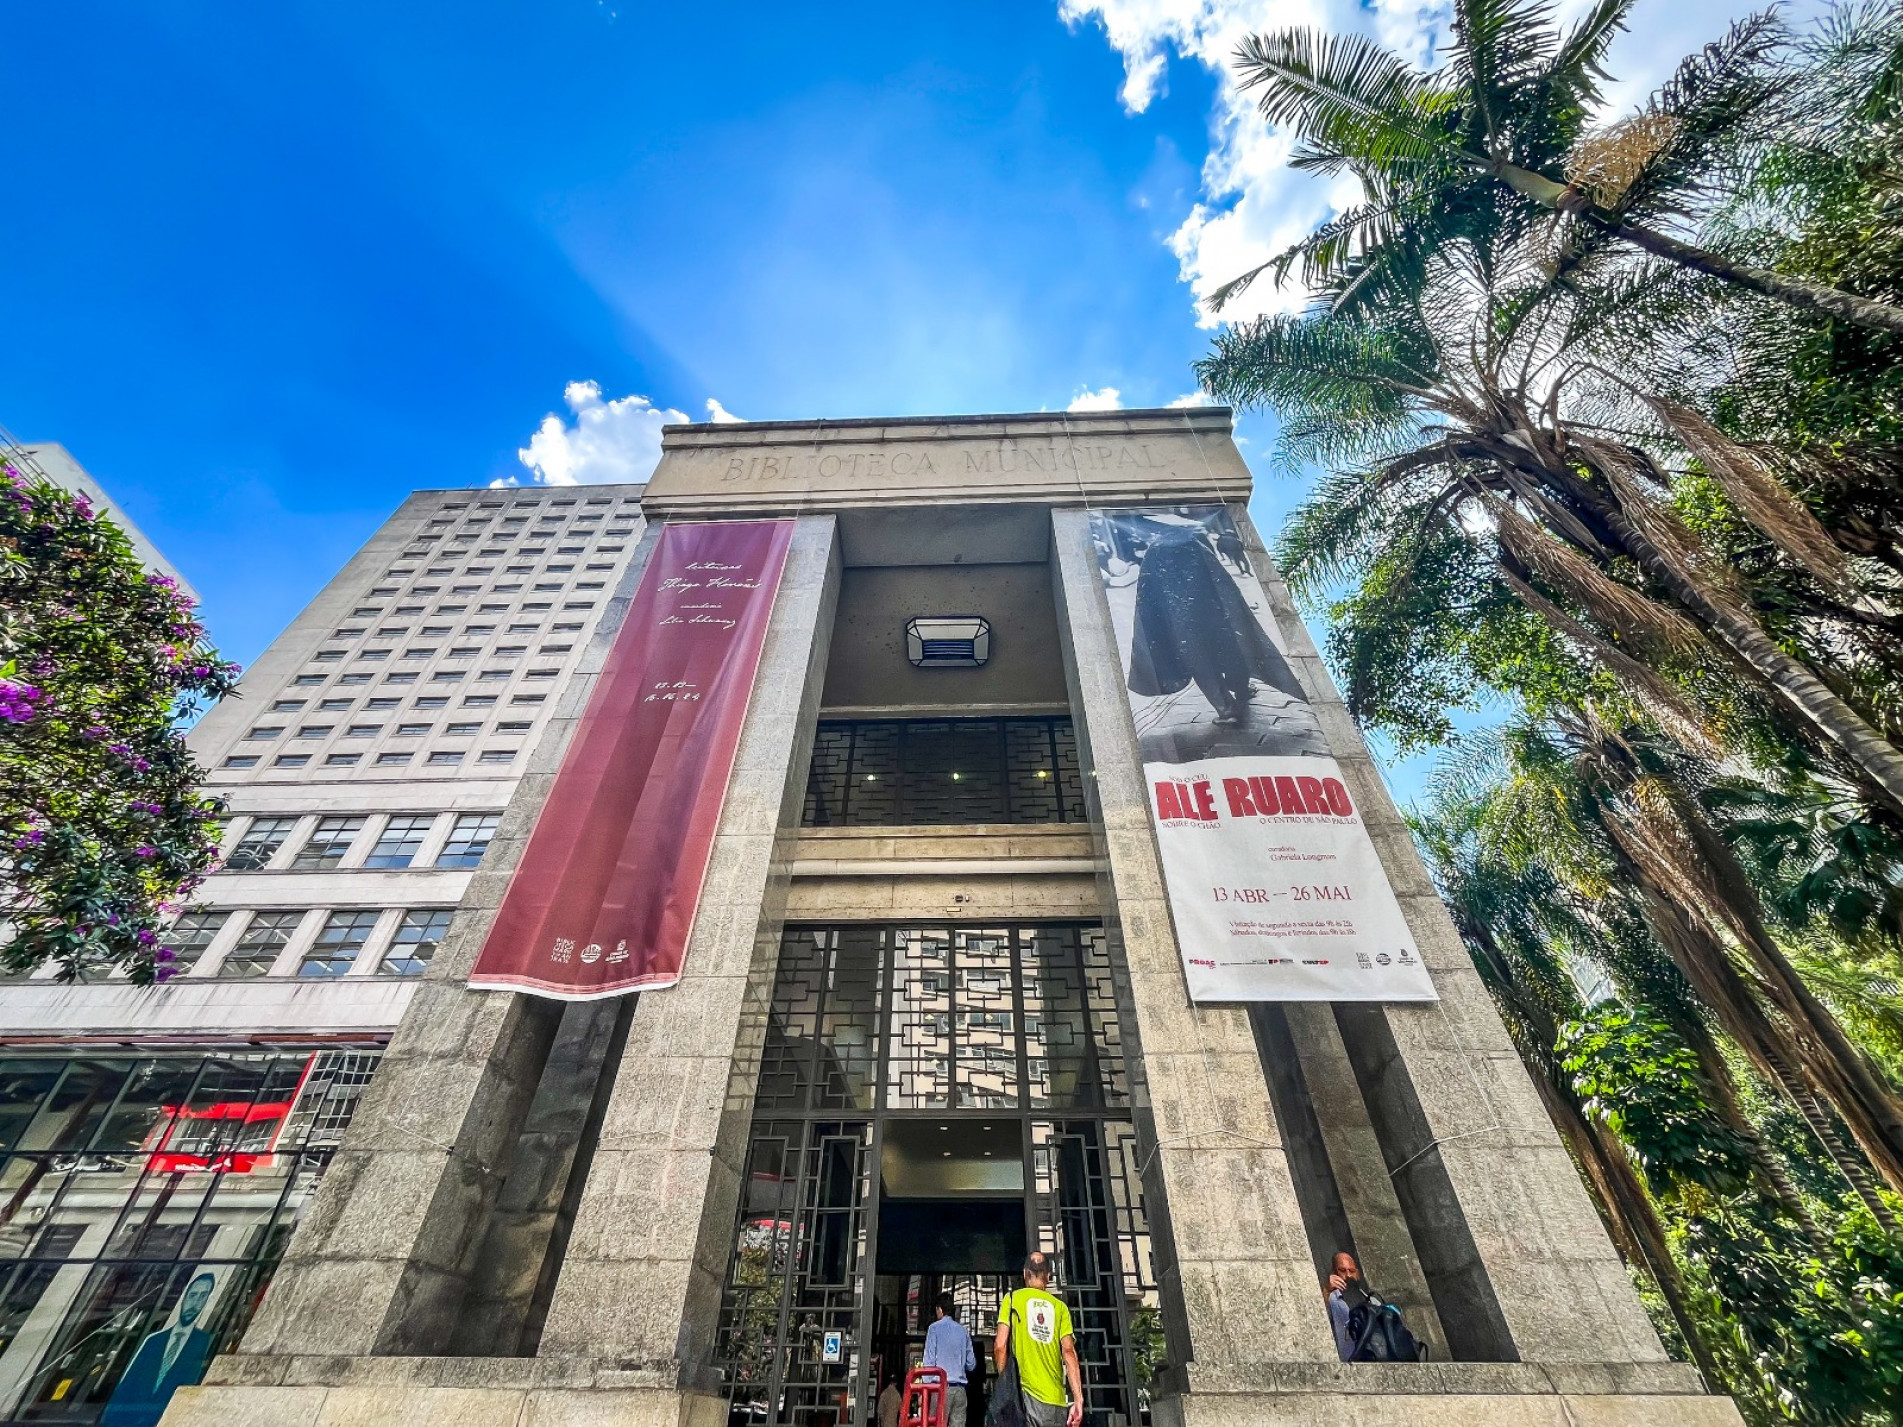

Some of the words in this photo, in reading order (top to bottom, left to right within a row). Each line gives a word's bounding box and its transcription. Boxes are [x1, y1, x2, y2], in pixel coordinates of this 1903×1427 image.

[721, 453, 937, 482] BIBLIOTECA
[963, 444, 1166, 474] MUNICIPAL
[1154, 780, 1219, 821] ALE
[1221, 776, 1353, 818] RUARO
[1260, 817, 1267, 825] O
[1267, 816, 1302, 824] CENTRO
[1332, 817, 1358, 825] PAULO
[1213, 887, 1229, 902] 13
[1233, 889, 1270, 904] ABR
[1290, 886, 1311, 901] 26
[1312, 885, 1352, 901] MAI
